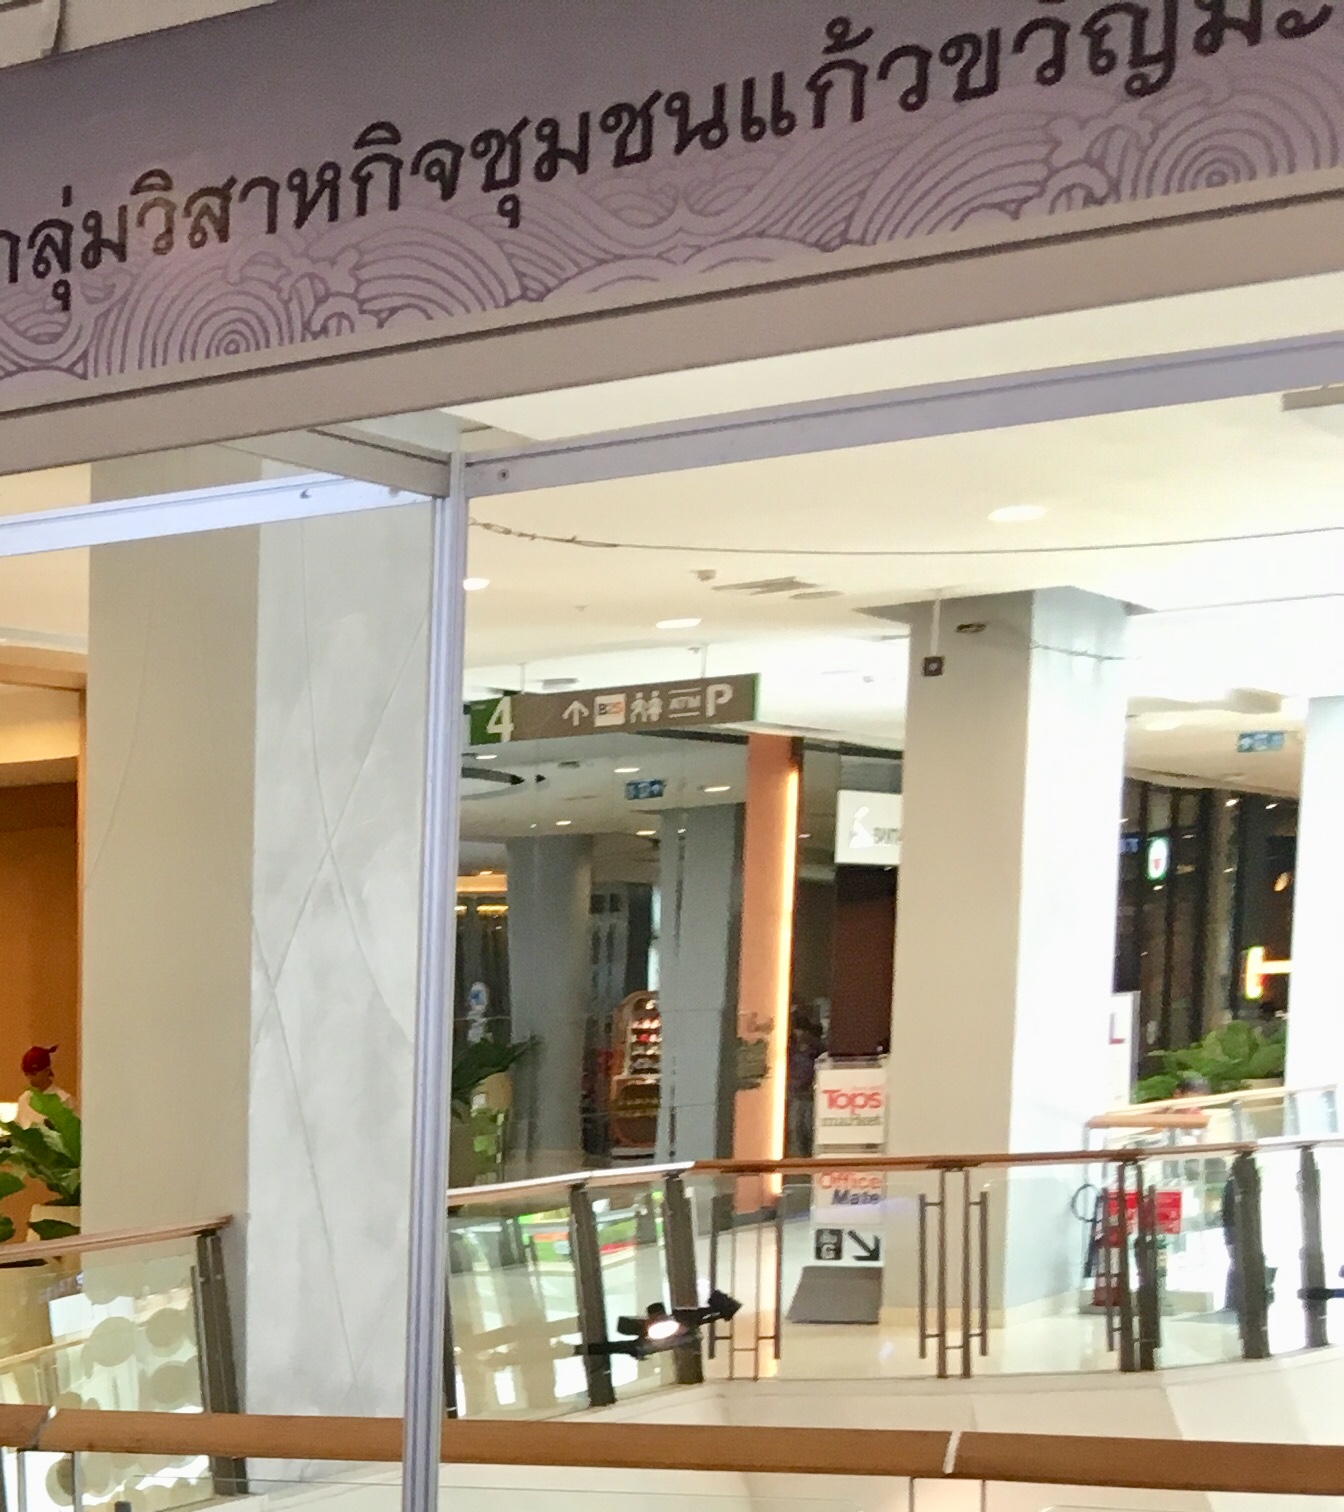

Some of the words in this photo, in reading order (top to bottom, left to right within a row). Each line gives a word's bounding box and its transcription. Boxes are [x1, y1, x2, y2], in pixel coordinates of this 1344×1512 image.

[486, 696, 515, 743] 4
[706, 683, 733, 717] P
[822, 1089, 883, 1116] Tops
